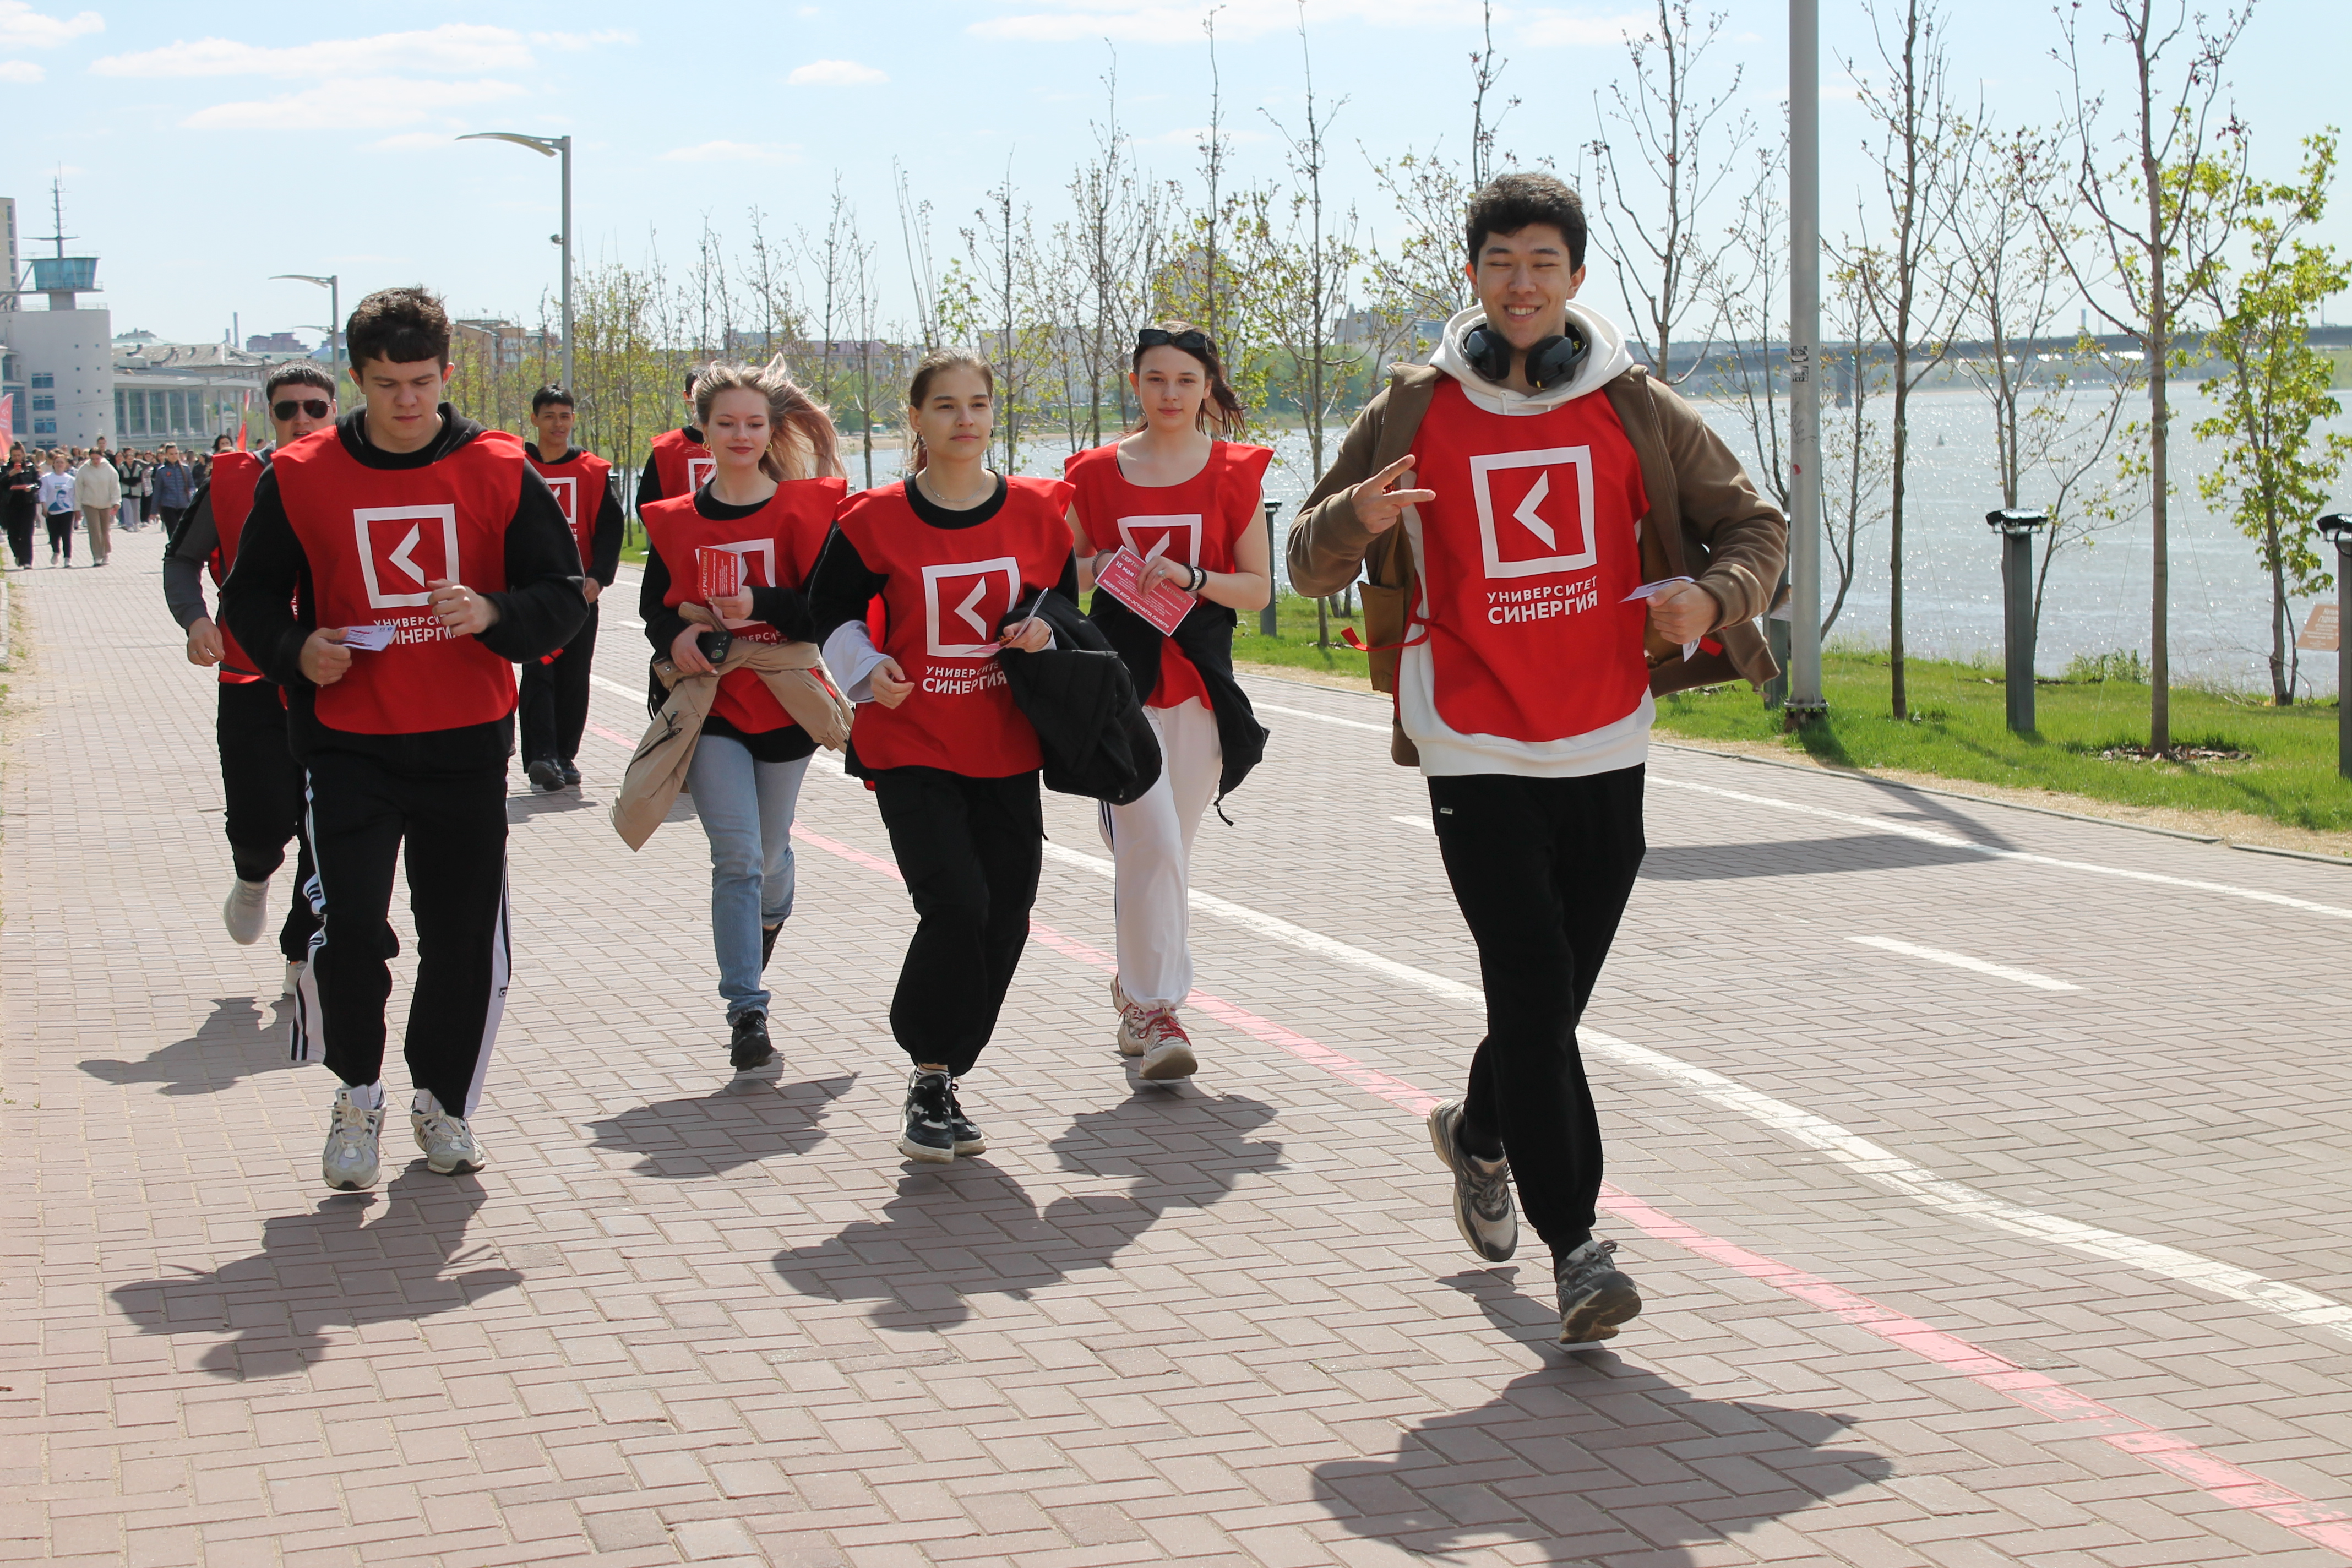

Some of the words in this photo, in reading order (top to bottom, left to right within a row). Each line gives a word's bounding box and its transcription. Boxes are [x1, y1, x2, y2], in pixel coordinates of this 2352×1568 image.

[1115, 560, 1124, 569] 15
[1122, 567, 1135, 578] мая
[1160, 582, 1187, 605] ЧАСТНИКА
[1487, 575, 1597, 605] УНИВЕРСИТЕТ
[1102, 579, 1121, 594] НЕДЕЛЯ
[1152, 615, 1170, 629] ПАМЯТИ
[1488, 590, 1598, 625] СИНЕРГИЯ
[373, 614, 447, 628] УНИВЕРСИ
[389, 625, 456, 645] ИНЕРГИ
[925, 660, 999, 679] УНИВЕРСИТЕ
[922, 671, 1008, 695] СИНЕРГИЯ
